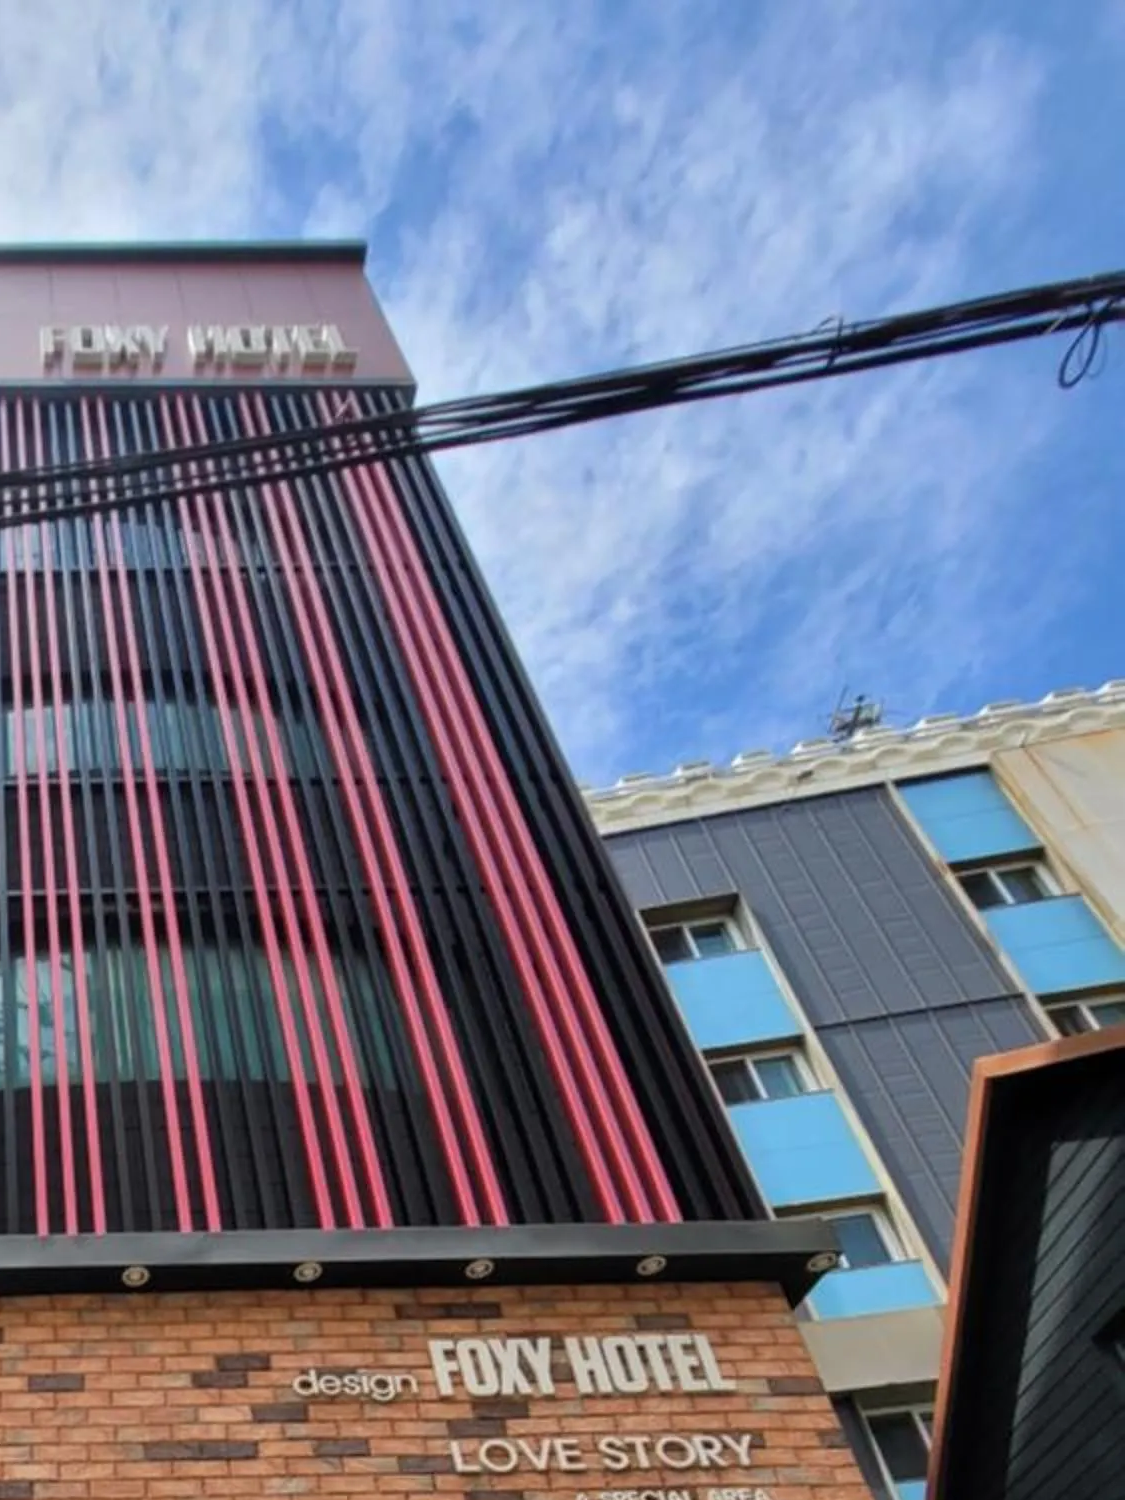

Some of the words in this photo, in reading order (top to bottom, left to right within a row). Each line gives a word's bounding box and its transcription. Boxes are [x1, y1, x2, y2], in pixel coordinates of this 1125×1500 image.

[38, 324, 170, 370] FOXY
[187, 324, 358, 370] HOTEL
[292, 1368, 419, 1402] design
[428, 1336, 556, 1397] FOXY
[566, 1333, 738, 1396] HOTEL
[449, 1437, 588, 1473] LOVE
[598, 1433, 753, 1471] STORY
